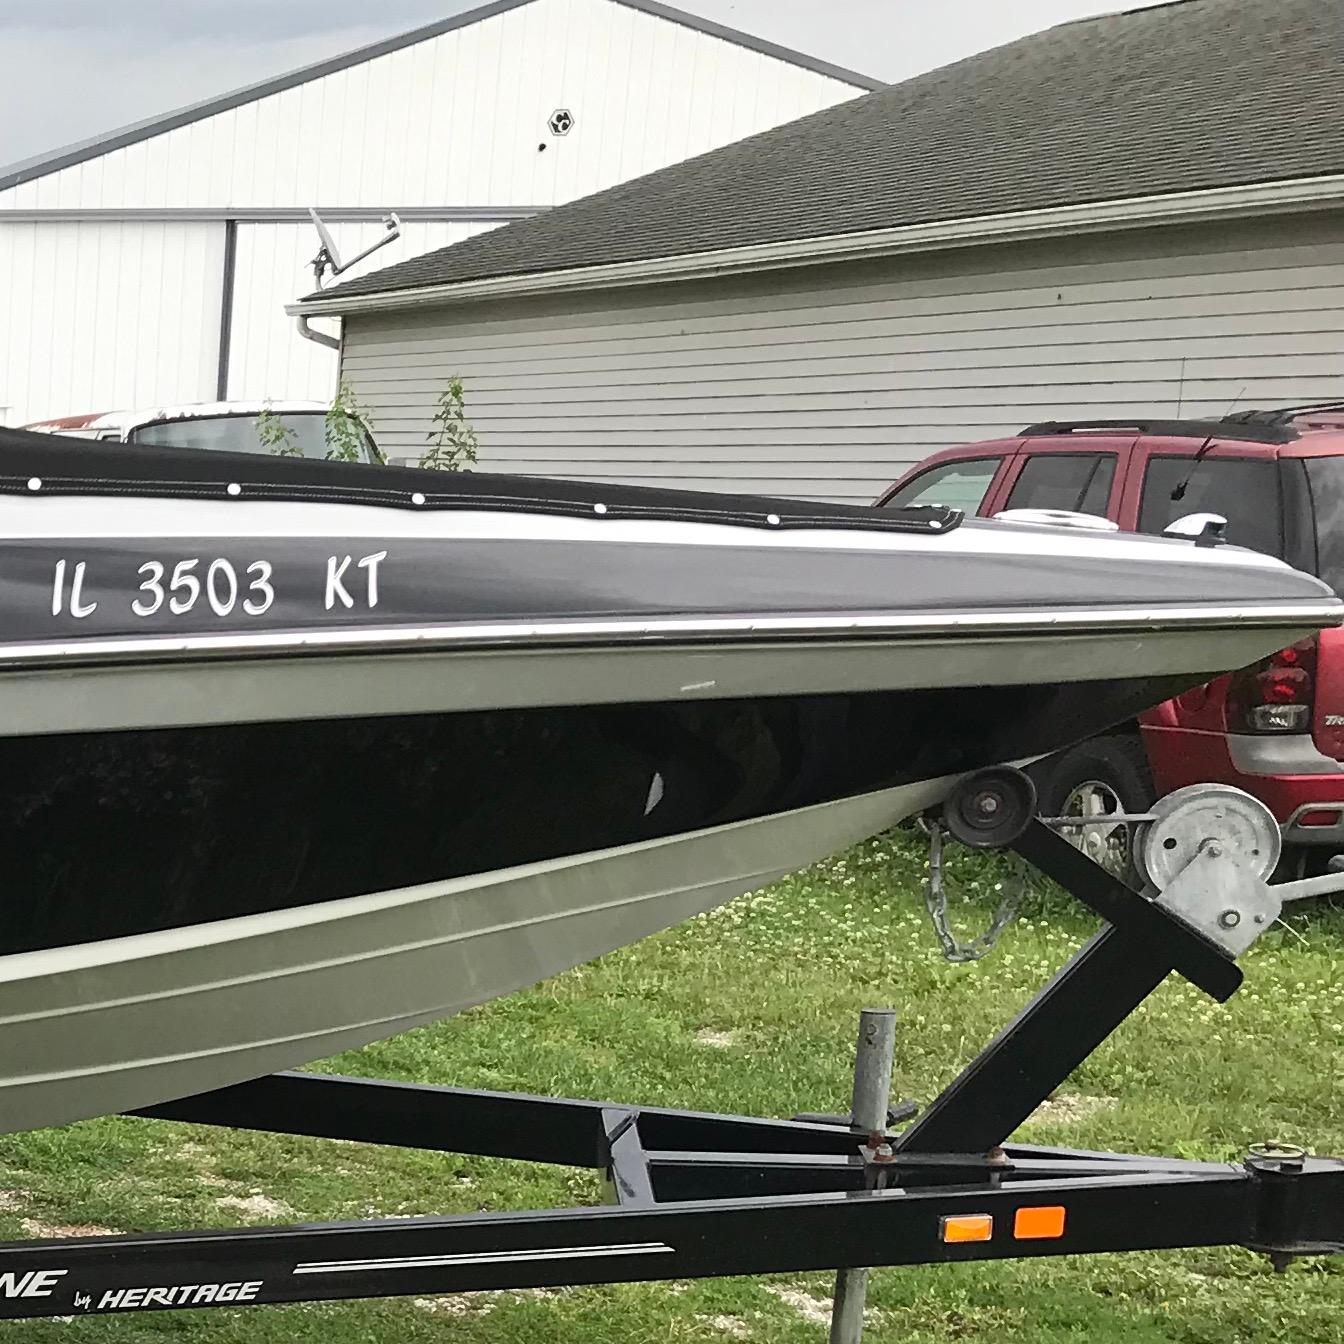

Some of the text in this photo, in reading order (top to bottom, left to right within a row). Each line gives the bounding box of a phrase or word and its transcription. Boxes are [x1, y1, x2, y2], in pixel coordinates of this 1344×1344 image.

[51, 550, 388, 618] IL 3503 KT
[1325, 714, 1344, 725] TR
[73, 1291, 92, 1310] by
[97, 1280, 264, 1309] HERITAGE
